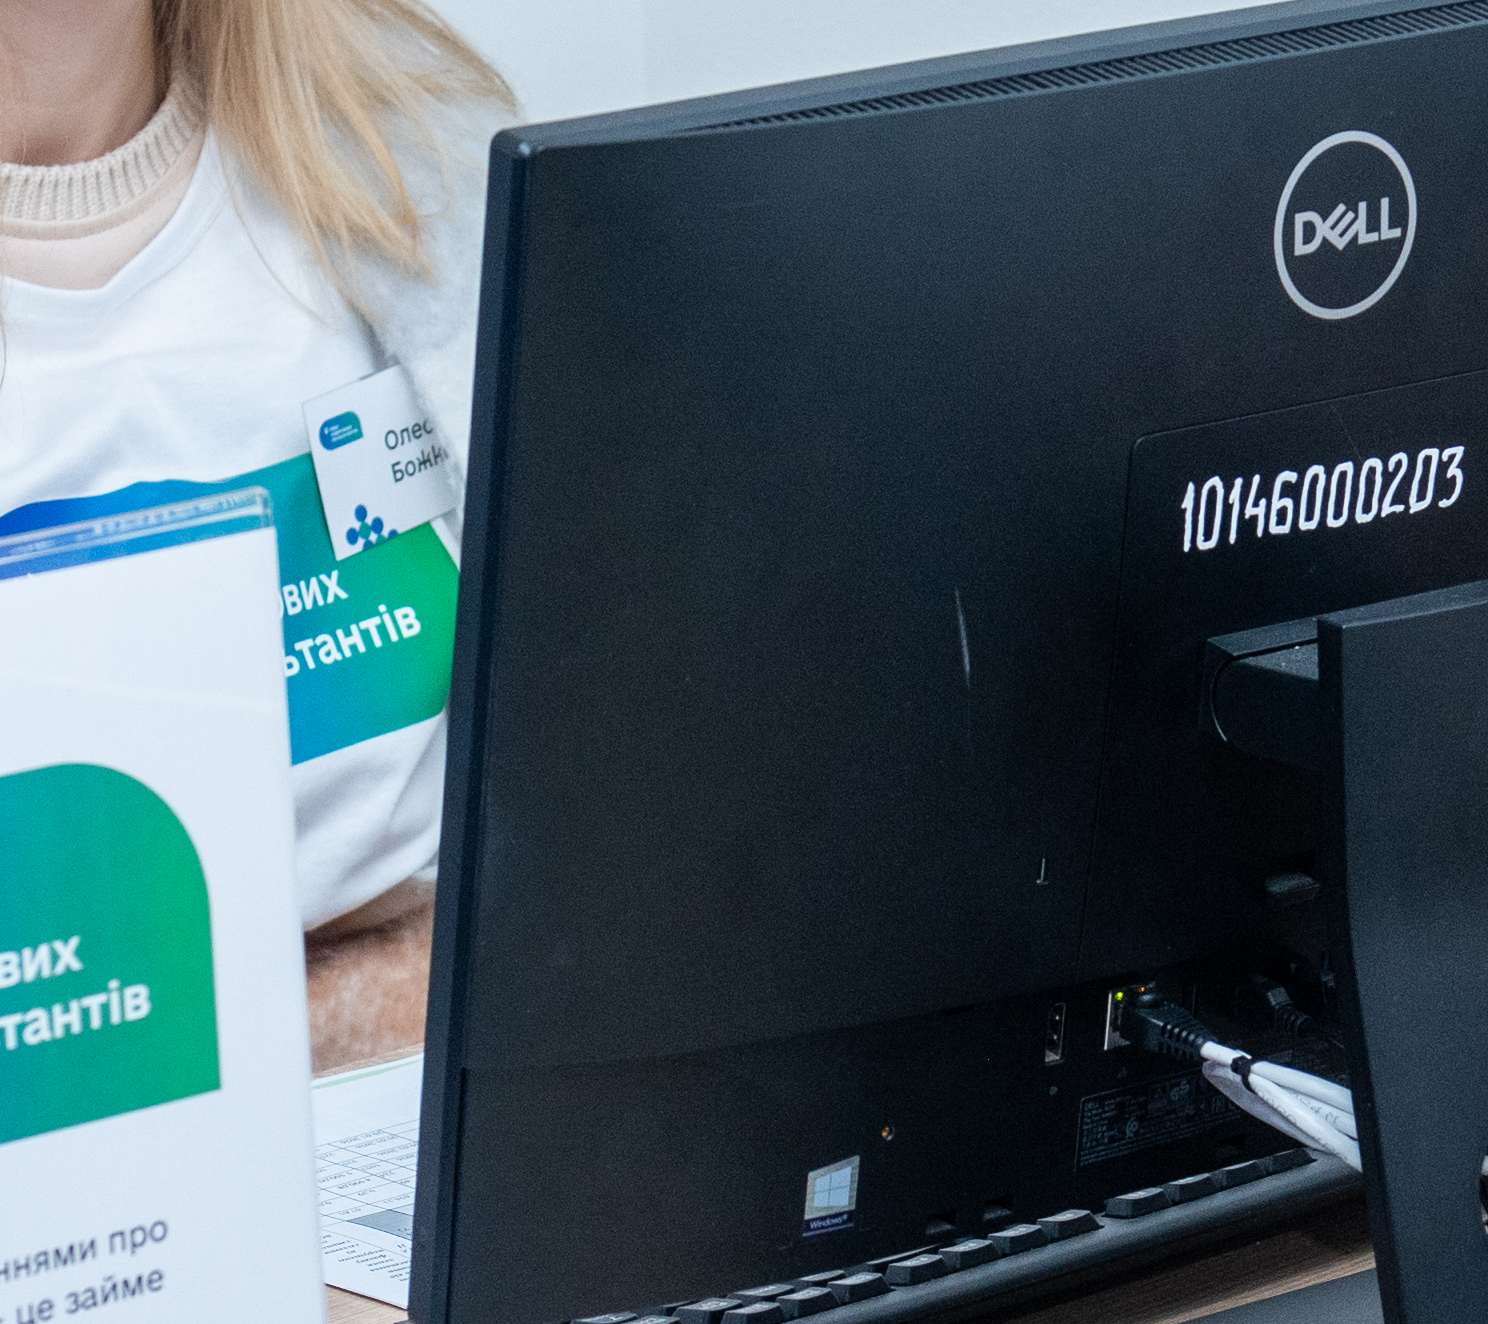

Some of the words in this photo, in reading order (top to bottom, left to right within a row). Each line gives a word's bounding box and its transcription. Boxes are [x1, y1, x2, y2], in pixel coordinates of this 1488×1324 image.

[1293, 197, 1402, 256] DELL
[1180, 444, 1465, 552] 10146000203
[280, 569, 349, 618] вих
[107, 1219, 169, 1256] про
[64, 1268, 165, 1316] займе
